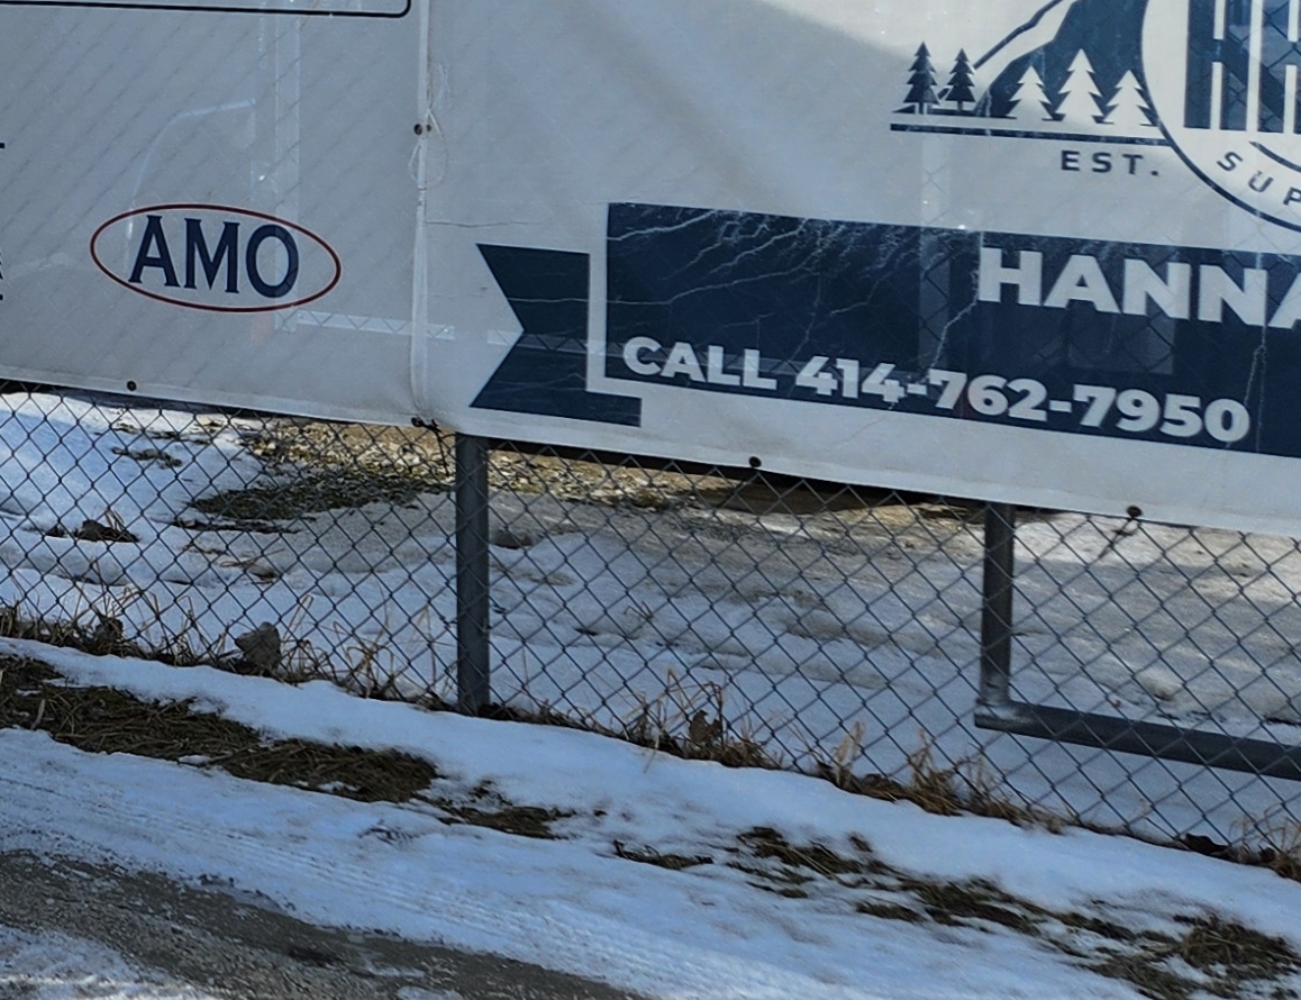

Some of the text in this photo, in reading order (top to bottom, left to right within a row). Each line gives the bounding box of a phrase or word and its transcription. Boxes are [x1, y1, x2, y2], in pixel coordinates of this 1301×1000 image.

[1061, 150, 1159, 177] EST.
[128, 214, 299, 299] AMO
[623, 336, 1251, 443] CALL 414-762-7950
